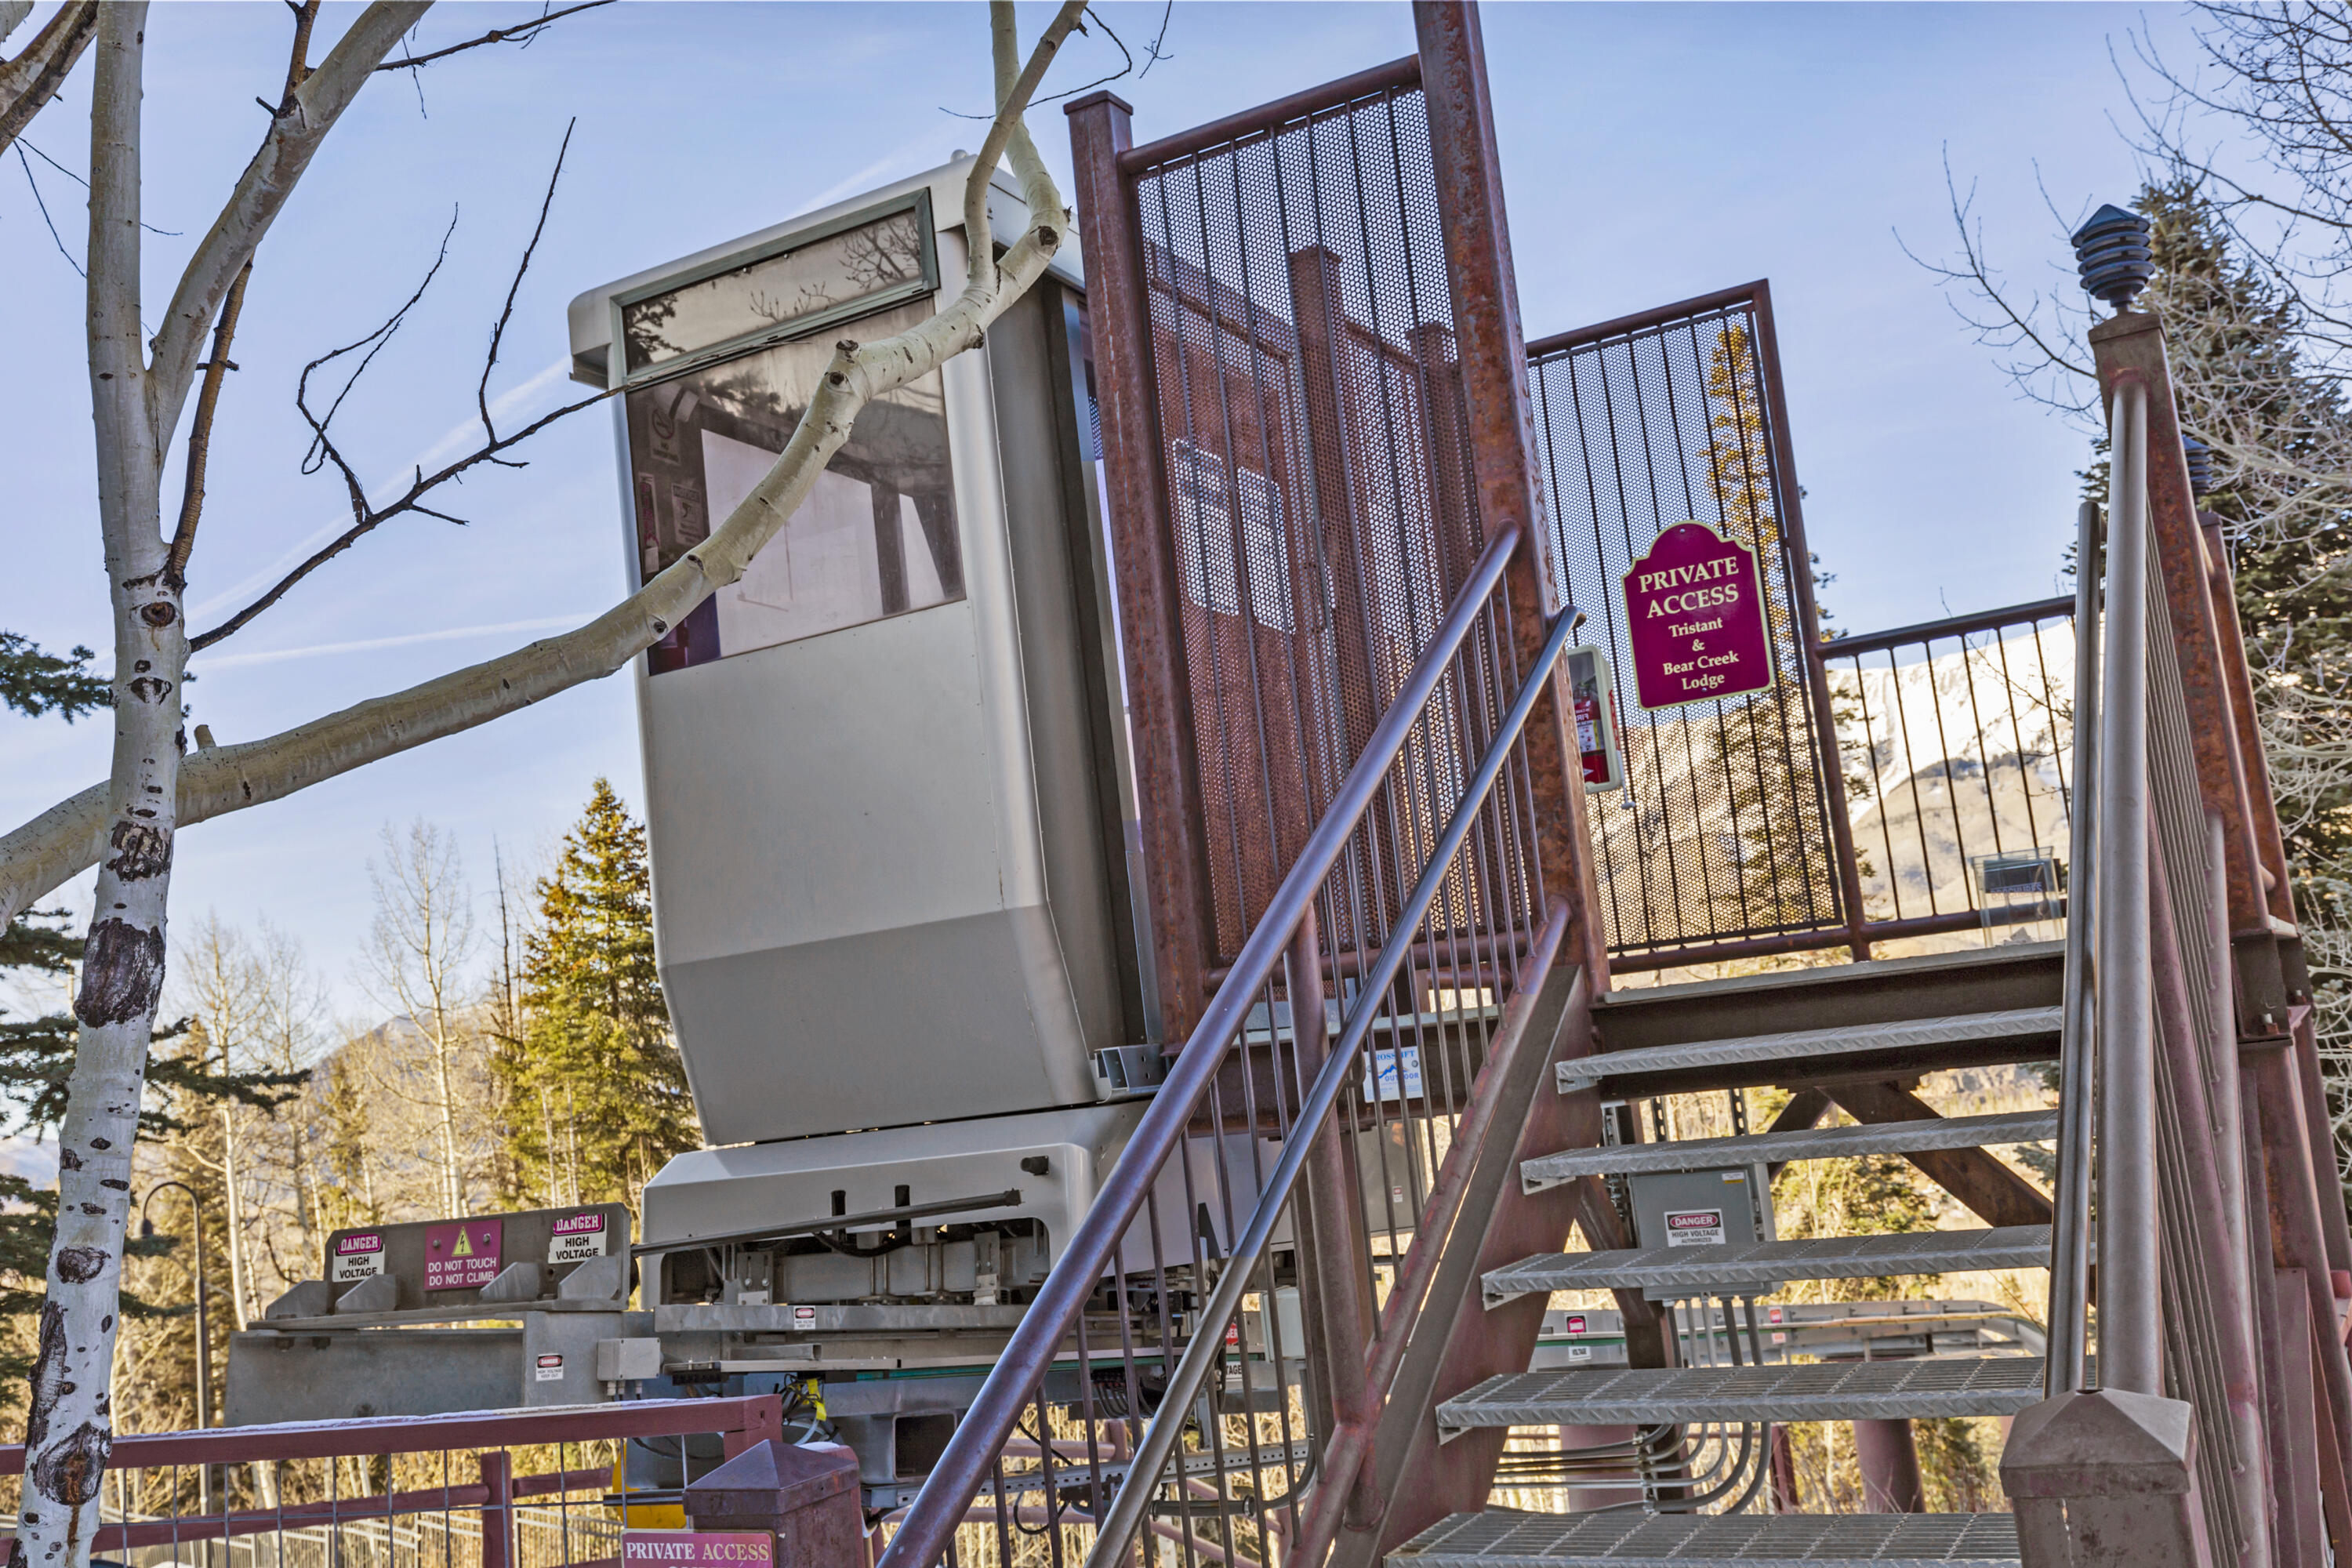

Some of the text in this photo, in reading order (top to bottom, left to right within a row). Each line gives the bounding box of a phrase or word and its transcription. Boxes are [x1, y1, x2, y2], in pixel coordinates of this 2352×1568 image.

[1638, 556, 1740, 593] PRIVATE
[1646, 583, 1740, 619] ACCESS
[1668, 617, 1723, 637] Tristant
[1691, 639, 1705, 652] &
[1662, 650, 1740, 676] Bear Creek
[1681, 673, 1725, 691] Lodge
[1377, 1051, 1414, 1060] ROSSIFT
[1385, 1073, 1418, 1081] OUTOOR
[556, 1214, 599, 1232] DANGER
[1674, 1216, 1713, 1226] DANGER
[340, 1235, 379, 1251] DANGER
[564, 1236, 590, 1247] HIGH
[556, 1247, 599, 1260] VOLTAGE
[347, 1256, 369, 1267] HIGH
[428, 1257, 497, 1273] DO NOT TOUCH
[339, 1267, 377, 1279] VOLTAGE
[429, 1271, 495, 1286] DO NOT CLIMB
[1226, 1365, 1242, 1374] TAGE
[626, 1542, 769, 1561] PRIVATE ACCESS
